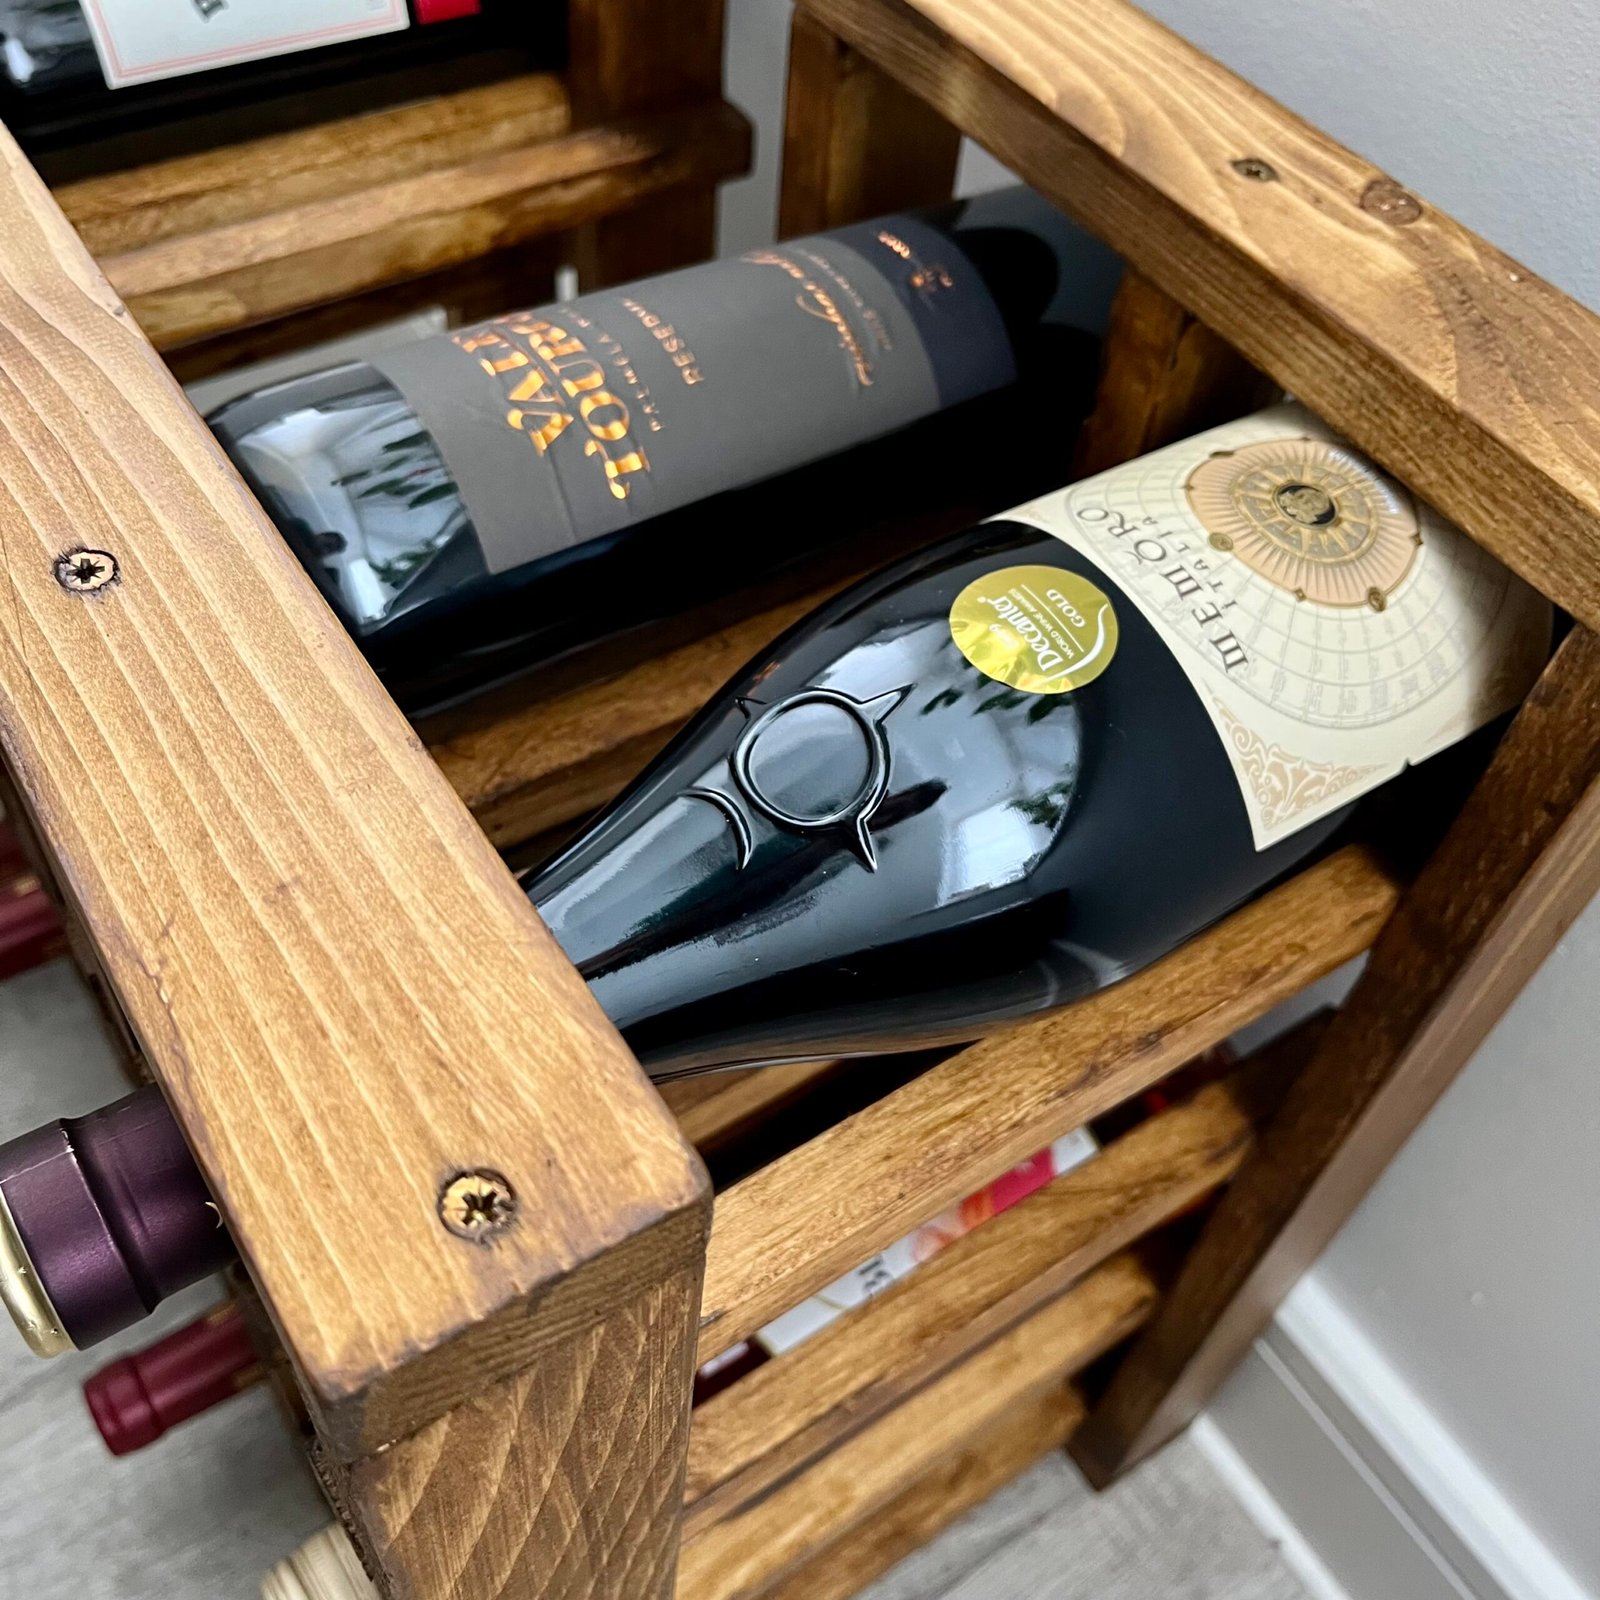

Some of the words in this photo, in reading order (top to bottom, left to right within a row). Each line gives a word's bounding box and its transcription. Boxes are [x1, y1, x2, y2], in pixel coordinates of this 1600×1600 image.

[598, 332, 664, 432] PALMELA
[1034, 611, 1053, 632] WINE
[1046, 589, 1086, 628] GOLD
[986, 594, 1065, 672] Decanter
[1051, 630, 1075, 659] WORLD
